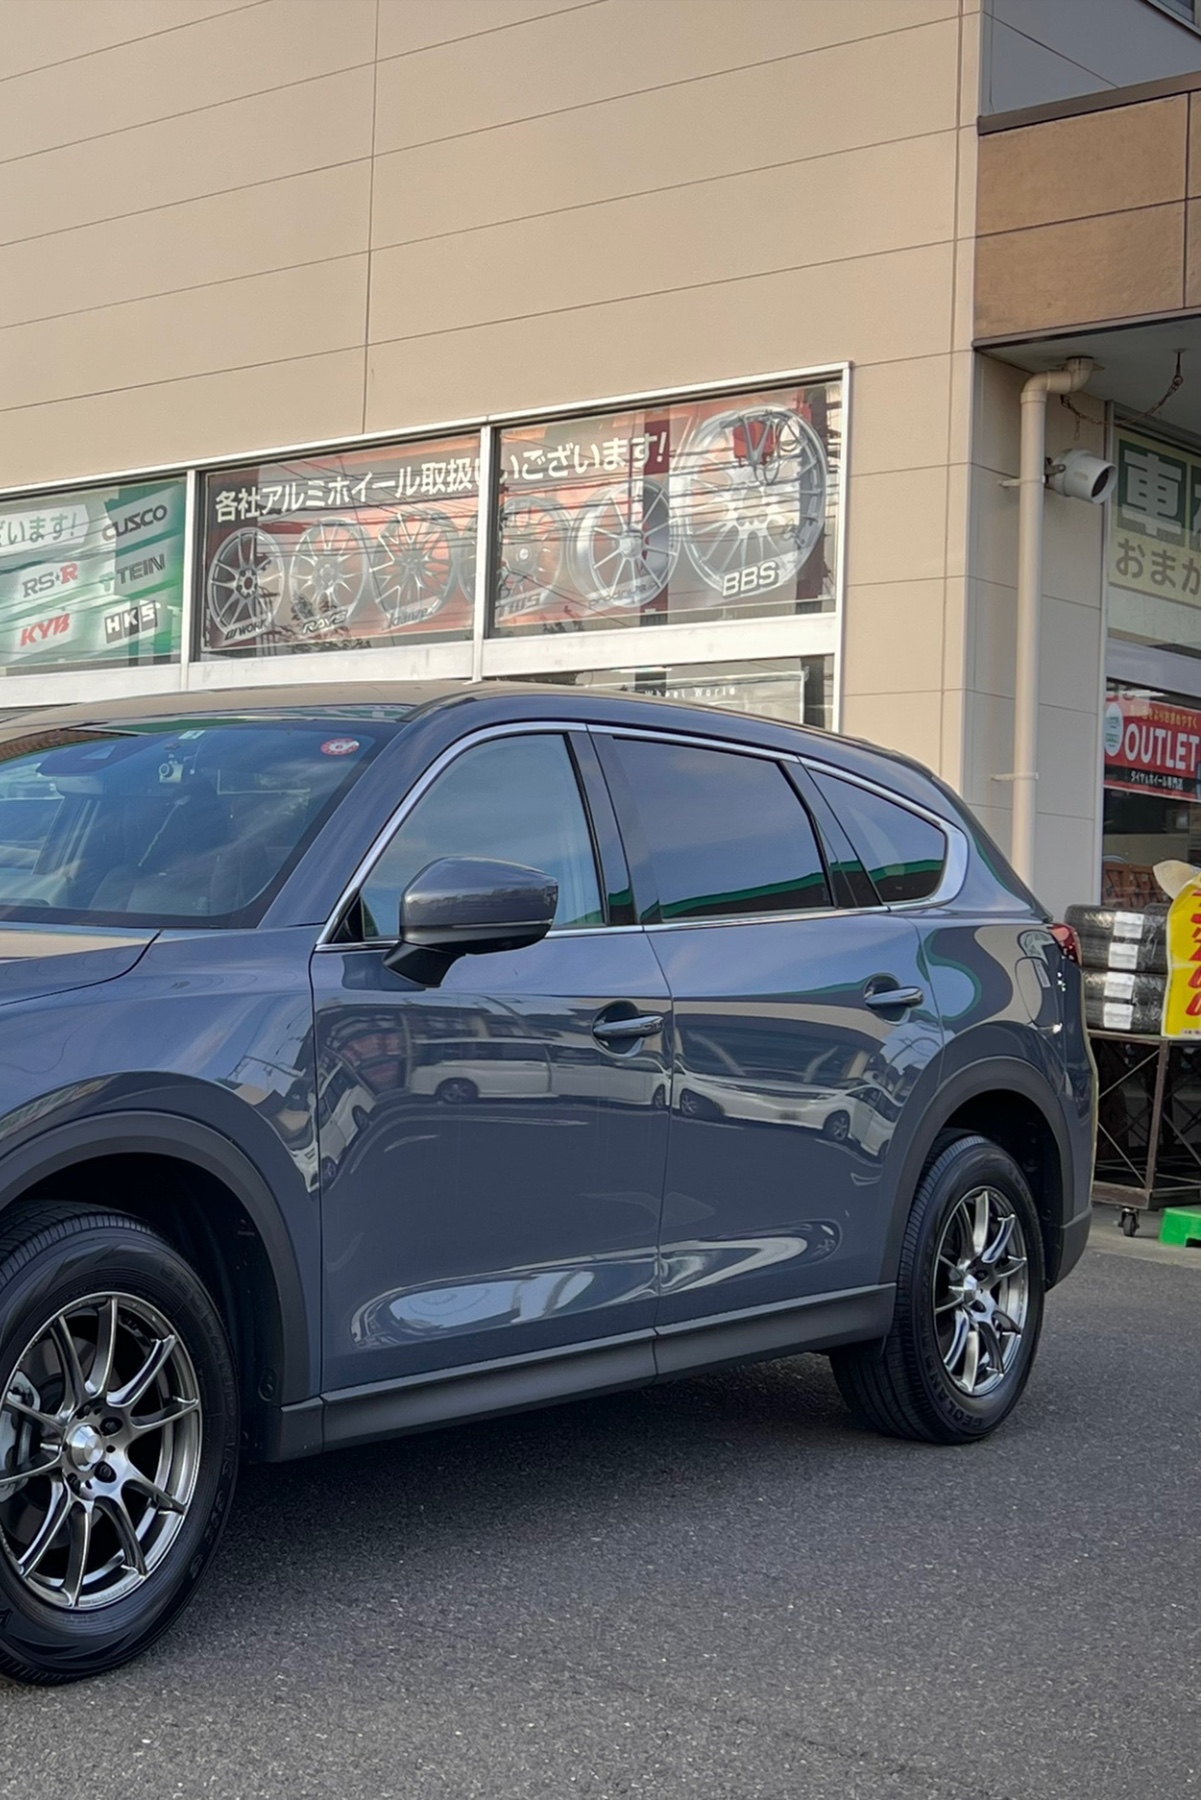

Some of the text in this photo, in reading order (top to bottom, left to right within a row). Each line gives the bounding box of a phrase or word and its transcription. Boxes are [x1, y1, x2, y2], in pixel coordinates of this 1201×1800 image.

[1121, 449, 1201, 538] 車
[101, 504, 168, 542] CUSCO
[116, 553, 165, 585] TEIN
[722, 560, 780, 597] BBS
[19, 613, 70, 647] KYB
[105, 600, 157, 638] HKS
[1124, 722, 1200, 772] OUTLET
